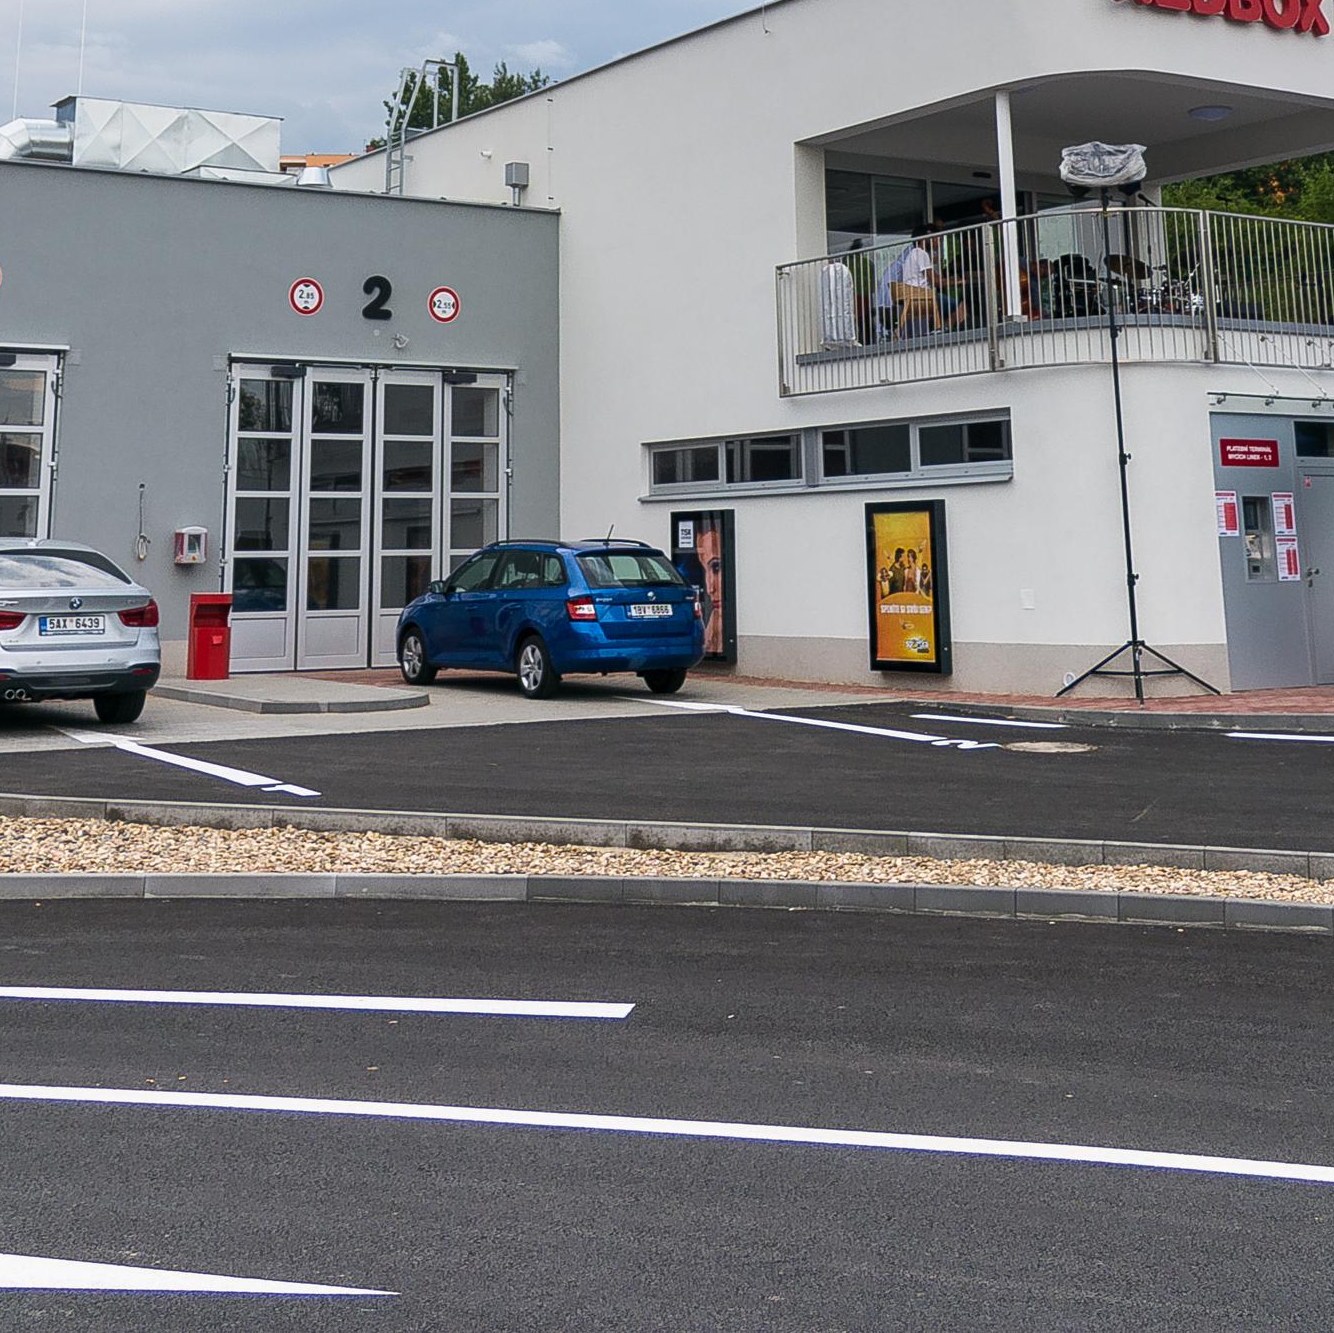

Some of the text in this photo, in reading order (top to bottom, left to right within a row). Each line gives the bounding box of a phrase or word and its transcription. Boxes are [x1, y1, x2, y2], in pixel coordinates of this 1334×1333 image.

[362, 275, 393, 321] 2
[49, 617, 100, 630] 5AX 6439
